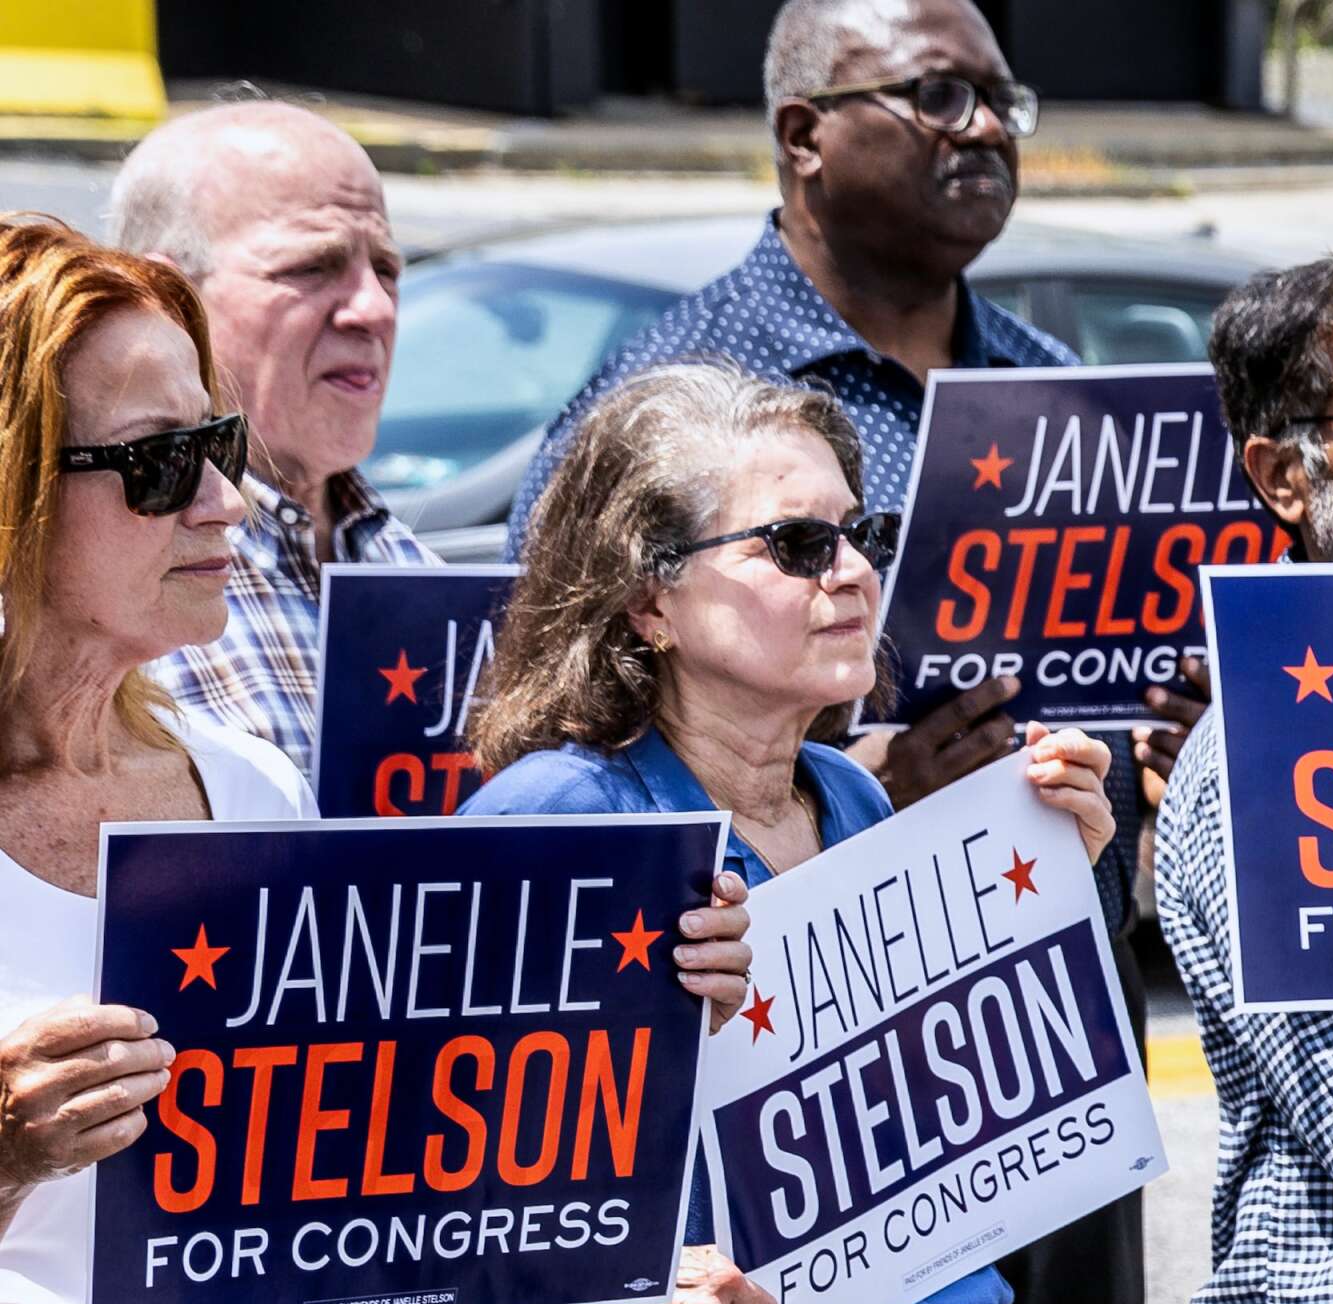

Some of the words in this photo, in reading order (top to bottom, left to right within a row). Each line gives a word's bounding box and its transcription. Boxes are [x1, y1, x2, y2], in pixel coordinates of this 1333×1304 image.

[1003, 411, 1262, 517] JANELL
[226, 878, 614, 1028] JANELLE
[783, 829, 1015, 1063] JANELLE
[153, 1027, 652, 1214] STELSON
[759, 943, 1098, 1240] STELSON
[145, 1227, 269, 1288] FOR
[291, 1198, 631, 1271] CONGRESS
[883, 1101, 1116, 1254] CONGRESS
[422, 1293, 454, 1304] STELSON
